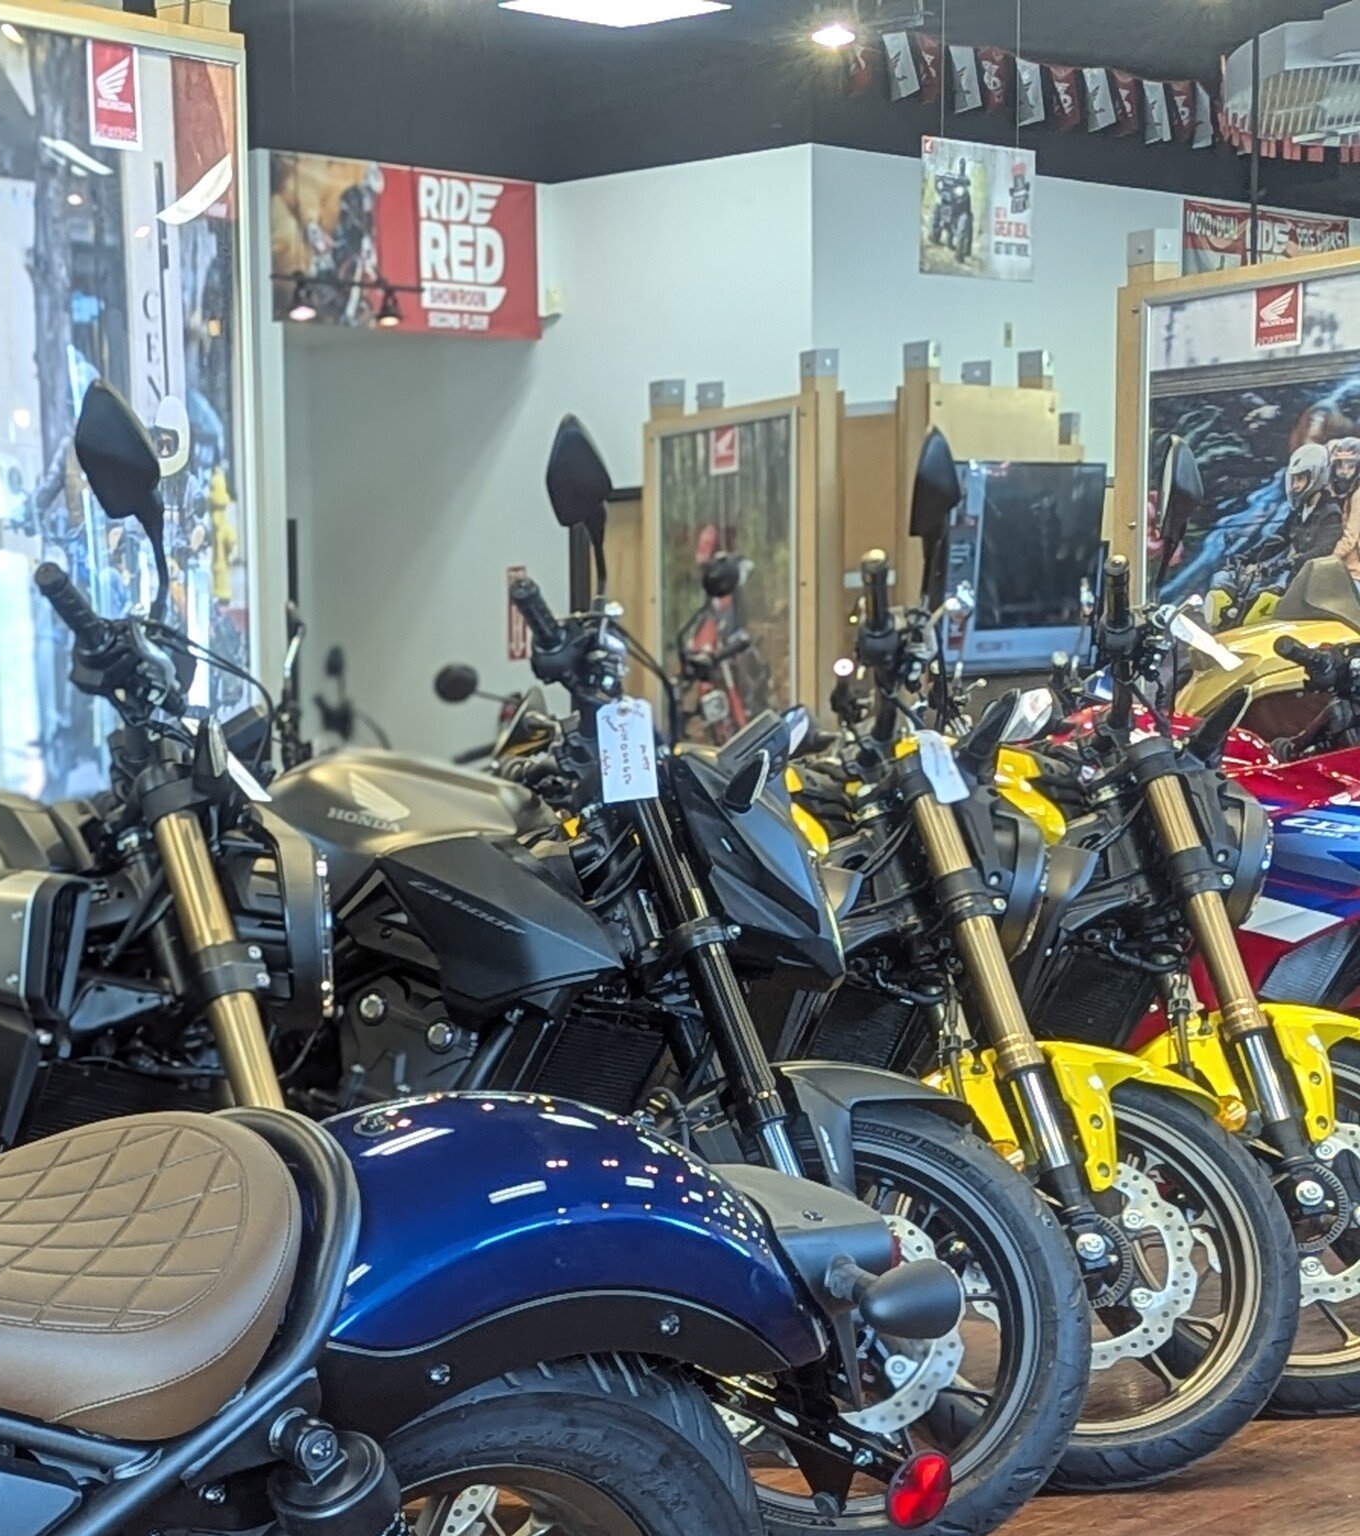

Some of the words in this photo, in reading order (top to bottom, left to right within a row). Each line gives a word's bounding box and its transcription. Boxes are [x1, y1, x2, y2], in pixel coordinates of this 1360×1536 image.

[418, 175, 504, 224] RIDE
[419, 220, 505, 285] RED
[326, 806, 400, 833] HONDA
